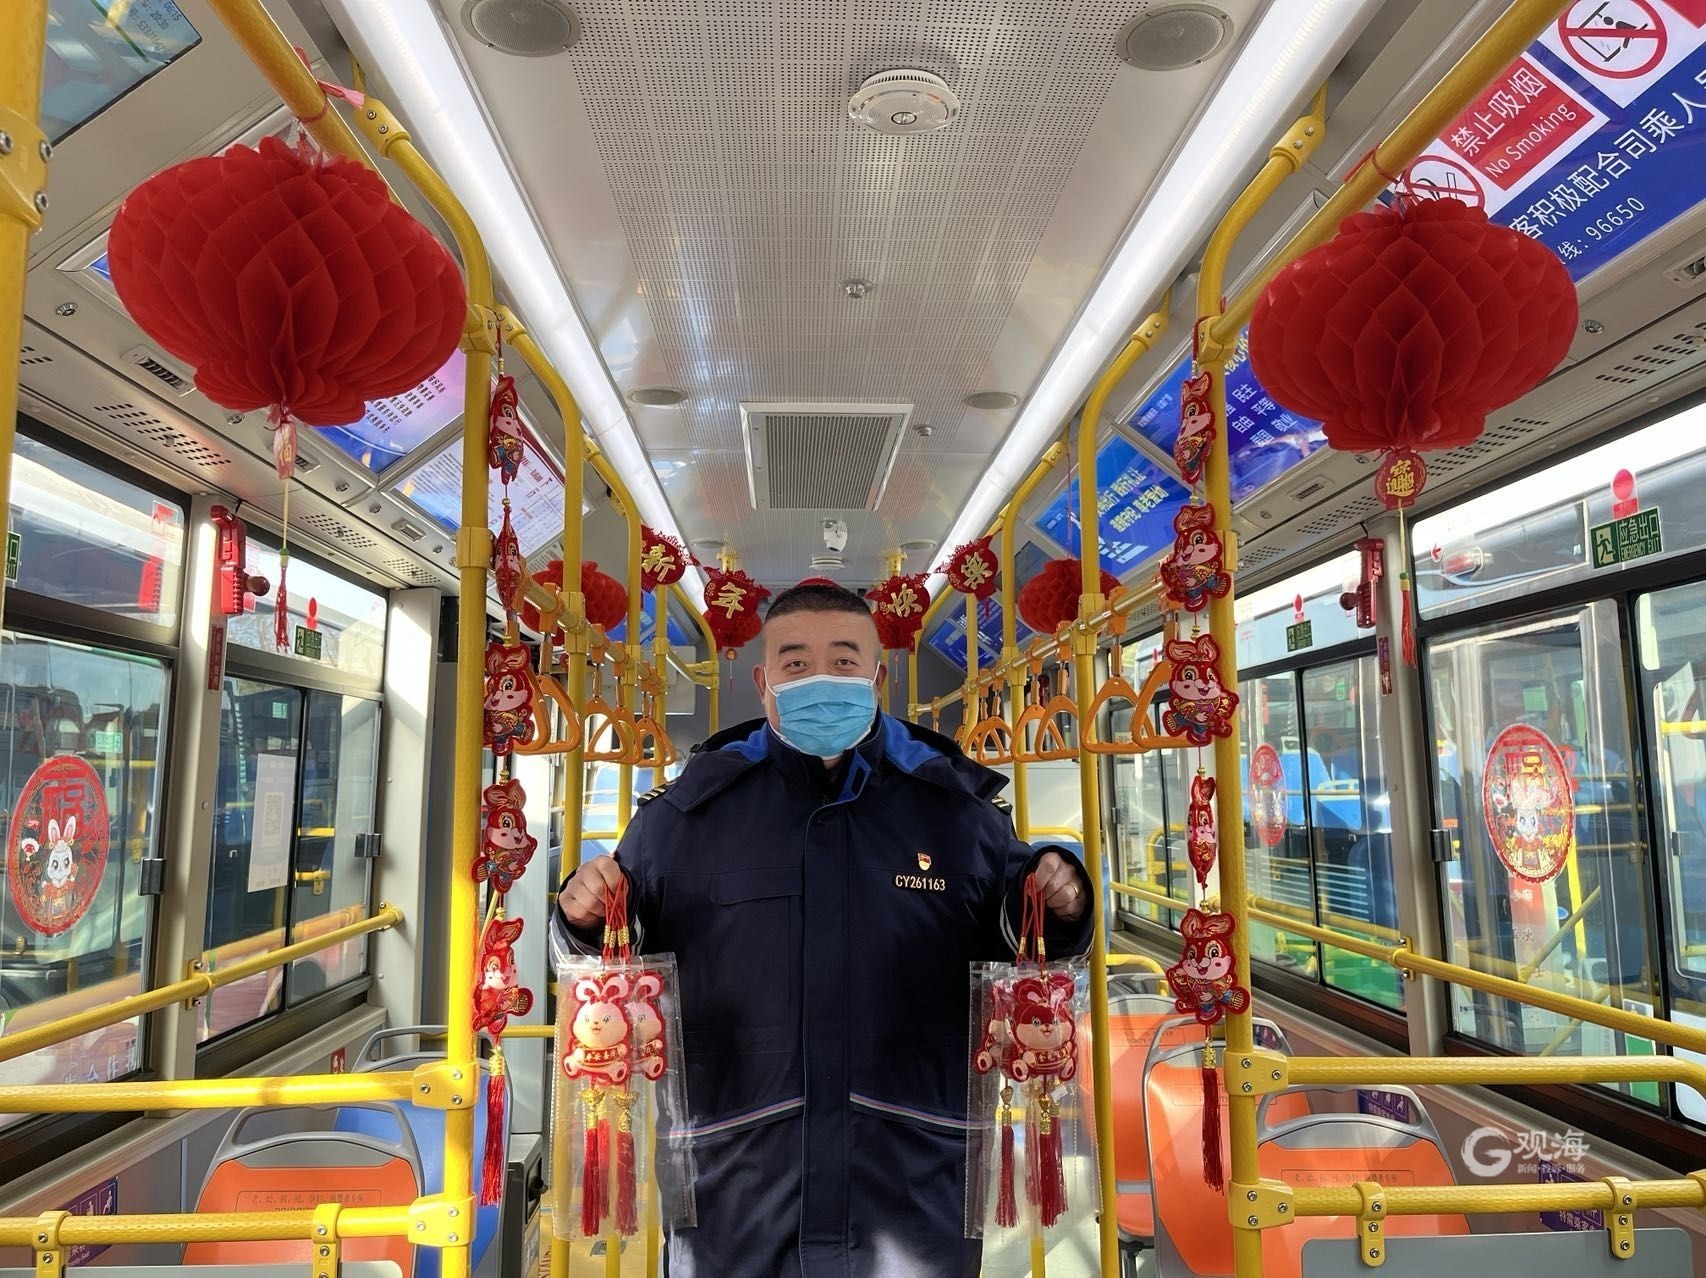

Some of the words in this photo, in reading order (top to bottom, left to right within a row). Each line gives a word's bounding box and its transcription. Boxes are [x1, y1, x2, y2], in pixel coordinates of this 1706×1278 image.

[1451, 66, 1547, 157] 禁止吸烟
[1485, 157, 1511, 178] No
[1512, 103, 1577, 161] Smoking
[1618, 513, 1660, 546] 应急出口
[1620, 541, 1647, 562] EMERGENCY
[1647, 537, 1661, 554] EXIT
[640, 543, 677, 583] 新
[710, 581, 748, 620] 年
[886, 582, 924, 618] 快
[894, 874, 946, 892] CY261163
